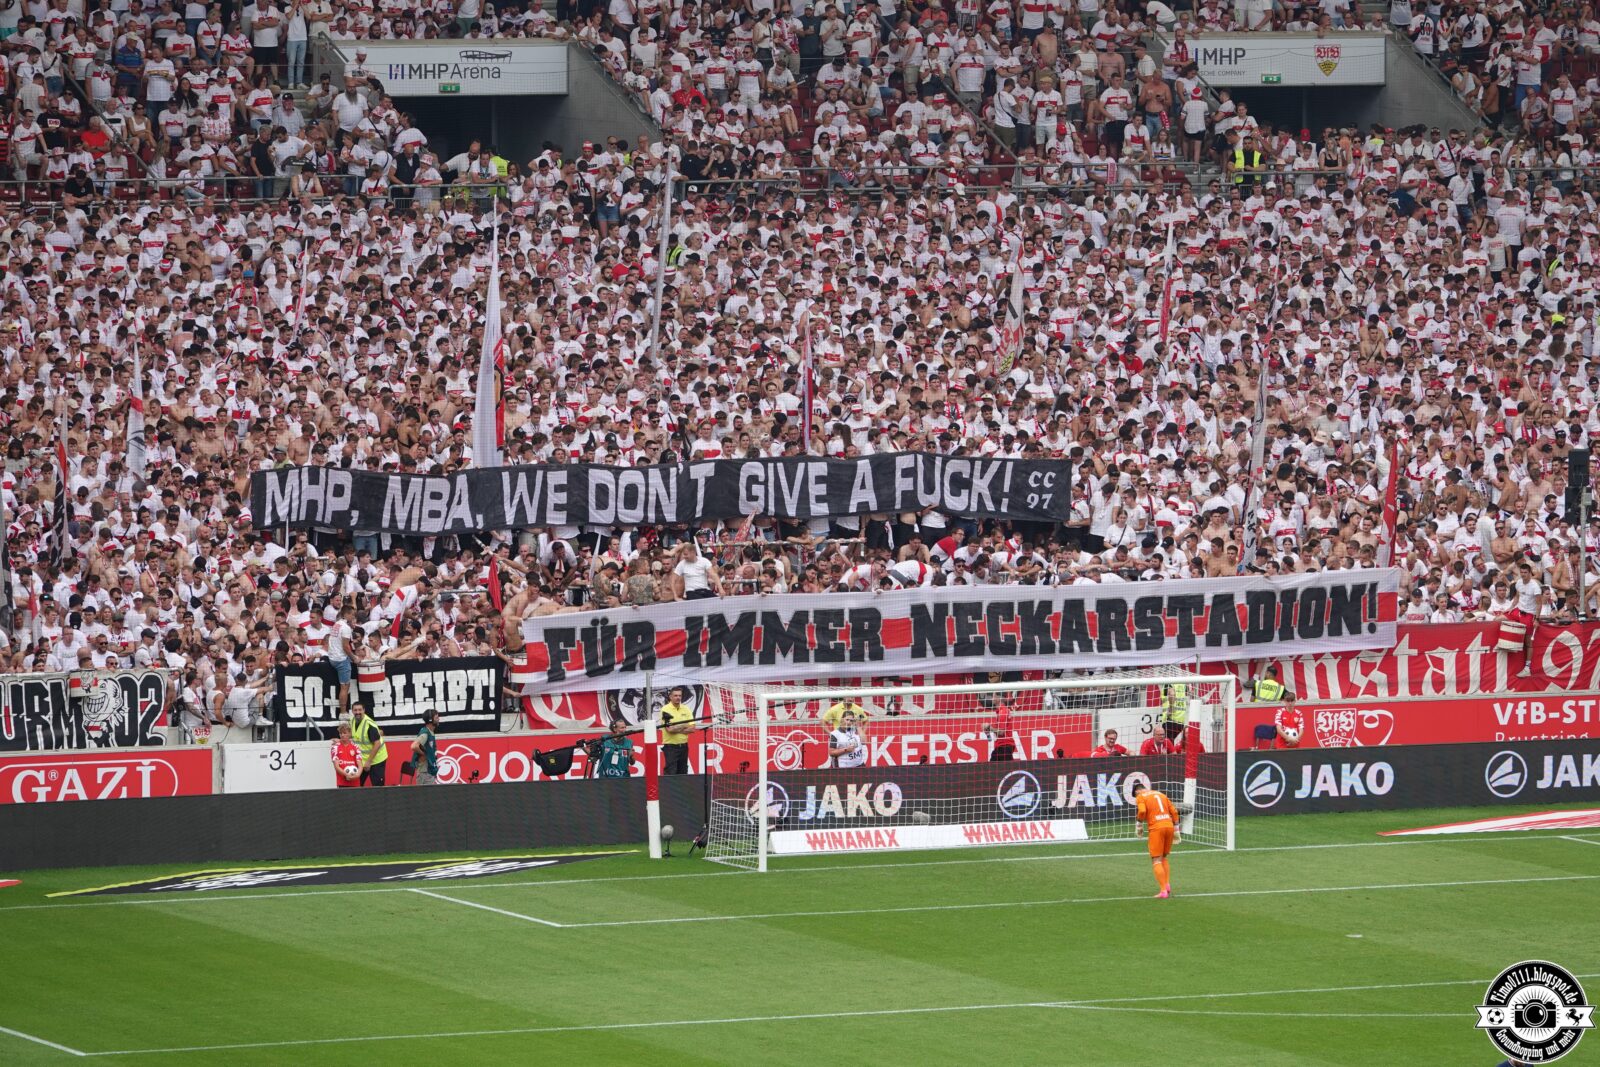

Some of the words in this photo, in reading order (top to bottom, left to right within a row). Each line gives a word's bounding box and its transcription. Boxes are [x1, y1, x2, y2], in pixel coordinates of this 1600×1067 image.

[1203, 48, 1246, 65] MHP
[1028, 470, 1056, 488] CC
[264, 467, 359, 526] MHP,
[382, 474, 484, 533] MBA,
[502, 470, 568, 526] WE
[588, 462, 715, 524] DON'T
[738, 461, 829, 517] GIVE
[848, 458, 878, 513] A
[894, 454, 1014, 513] FUCK!
[1026, 493, 1053, 510] 97
[543, 617, 657, 683] FÜR
[683, 607, 885, 668] IMMER
[910, 582, 1380, 659] NECKARSTADION!
[373, 668, 496, 718] BLEIBT!
[113, 671, 168, 748] 02
[1492, 700, 1600, 725] VfB-ST
[1141, 714, 1164, 734] 3
[269, 750, 297, 770] 34
[1052, 771, 1151, 808] JAKO
[1294, 762, 1394, 798] JAKO
[799, 781, 903, 821] JAKO
[1154, 794, 1164, 812] 1
[806, 828, 900, 851] WINAMAX
[962, 821, 1056, 844] WINAMAX
